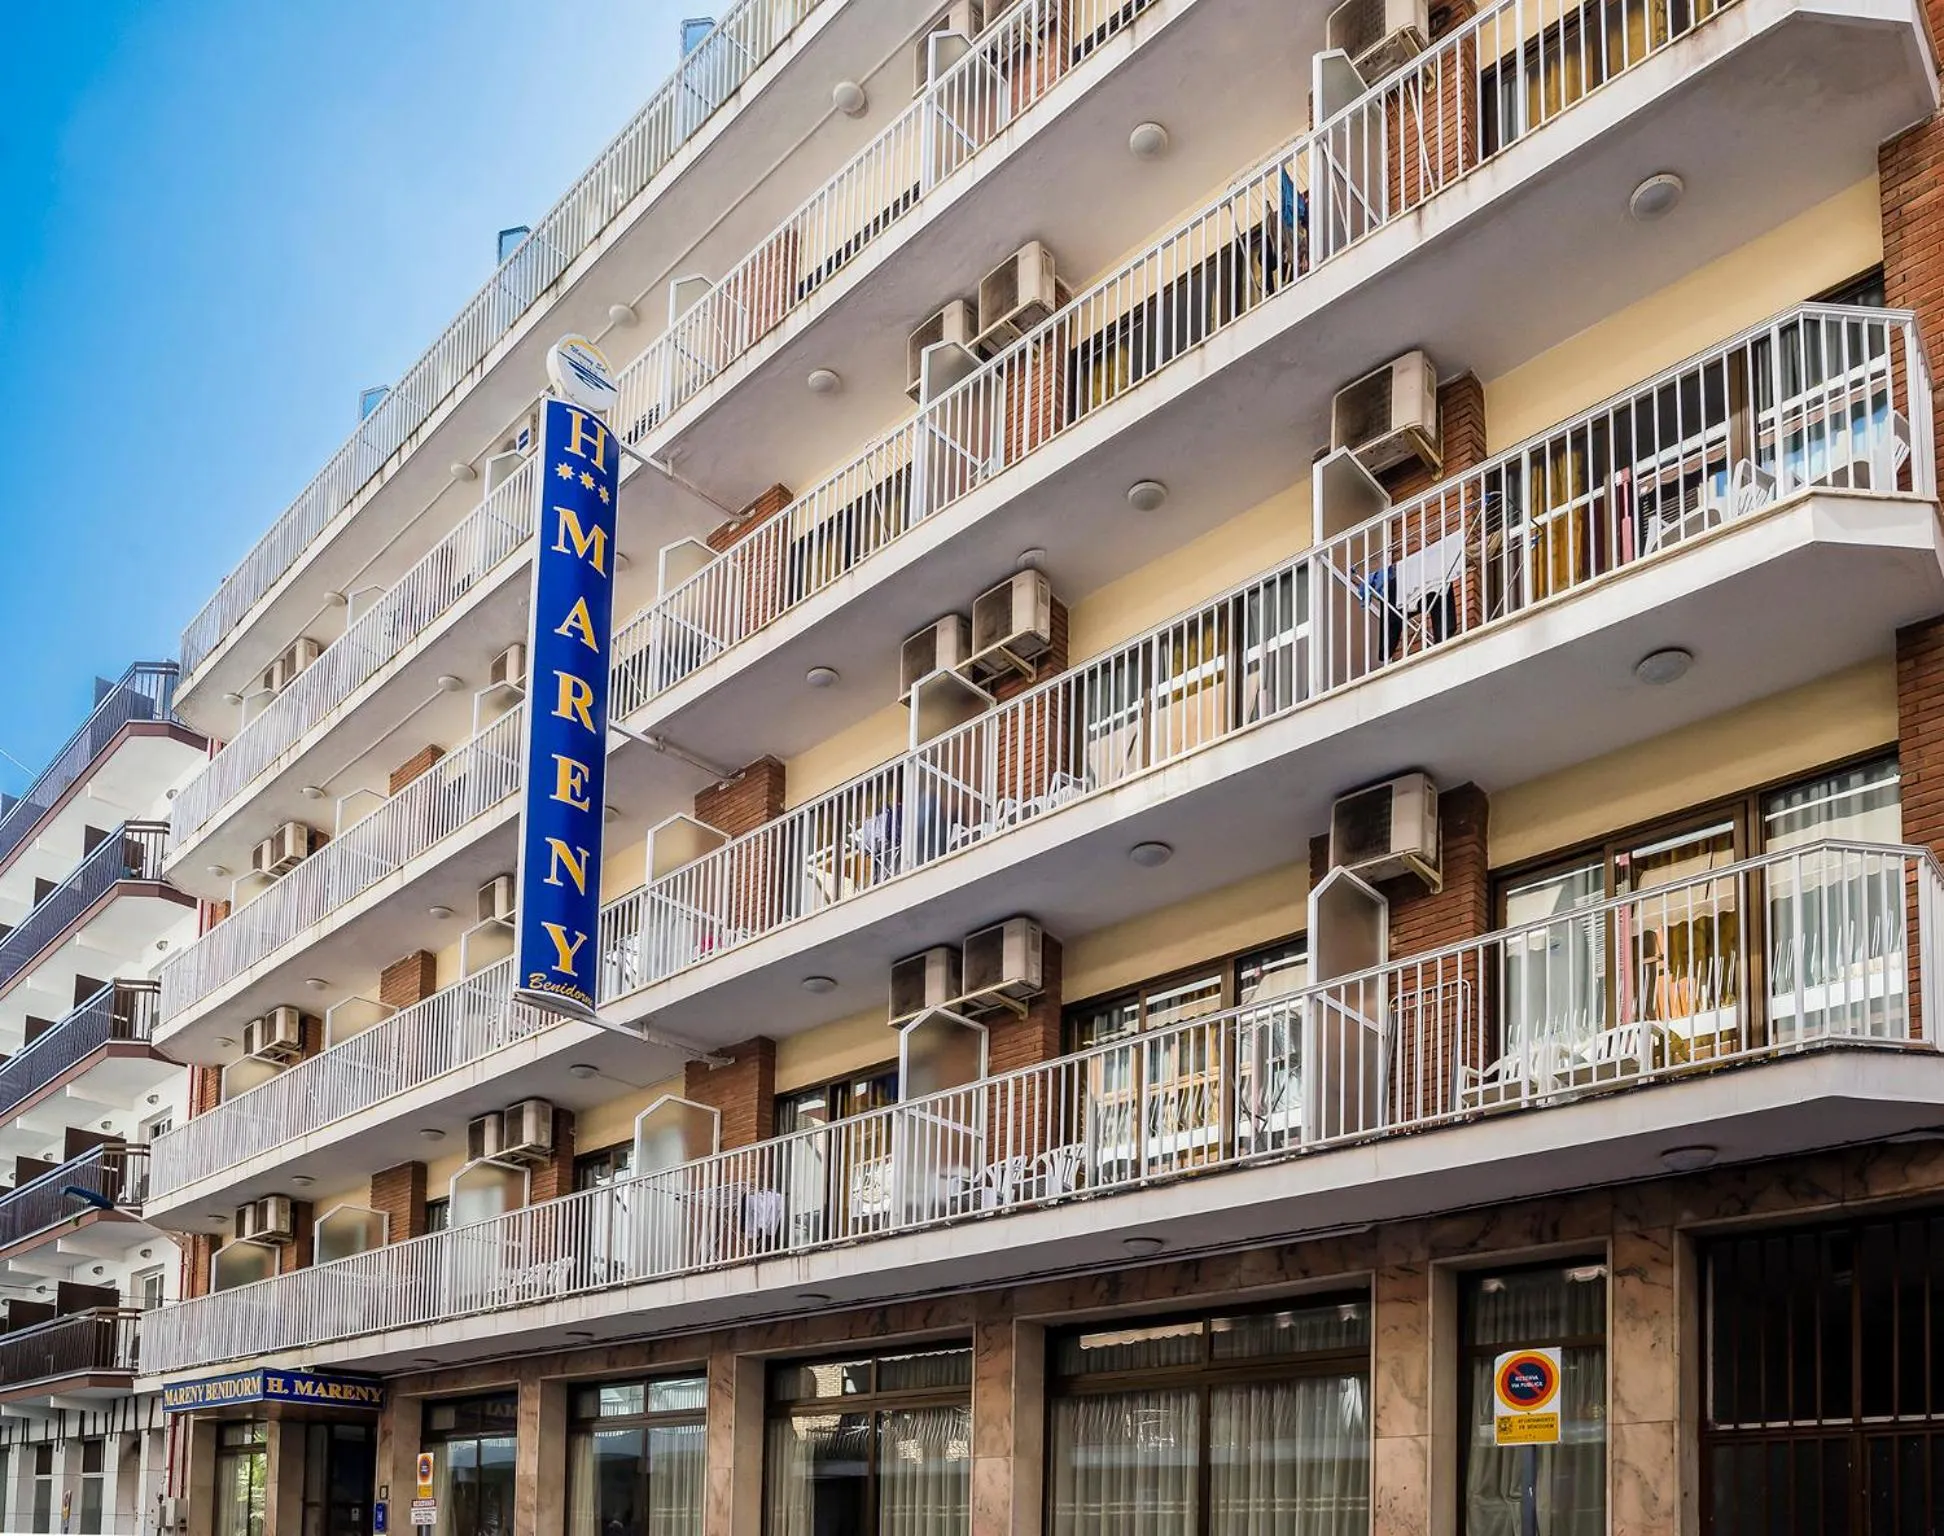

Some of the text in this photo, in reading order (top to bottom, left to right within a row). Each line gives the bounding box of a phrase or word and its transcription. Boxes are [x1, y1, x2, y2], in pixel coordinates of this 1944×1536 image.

[563, 407, 608, 476] H
[540, 506, 609, 977] MARENY
[528, 972, 593, 1006] Benidorm
[164, 1376, 261, 1406] MARENY BENIDORM
[266, 1376, 384, 1402] H. MARENY
